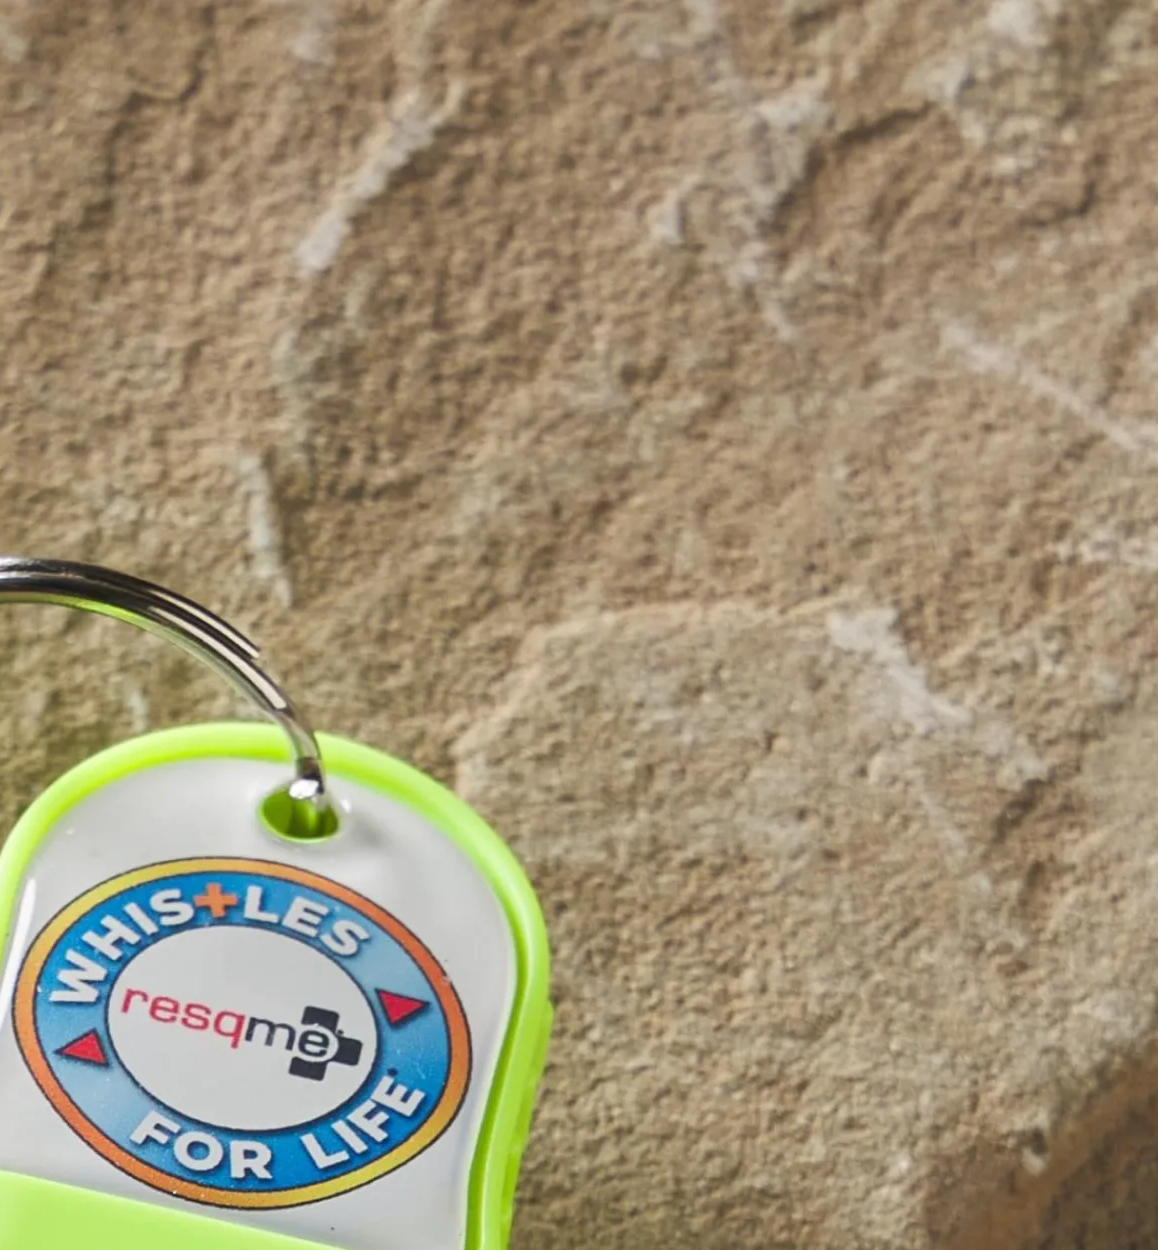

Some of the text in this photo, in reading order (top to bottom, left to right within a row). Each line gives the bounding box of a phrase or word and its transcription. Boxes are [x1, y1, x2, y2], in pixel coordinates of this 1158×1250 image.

[120, 987, 331, 1058] resqme
[129, 1074, 426, 1181] FOR LIFE
